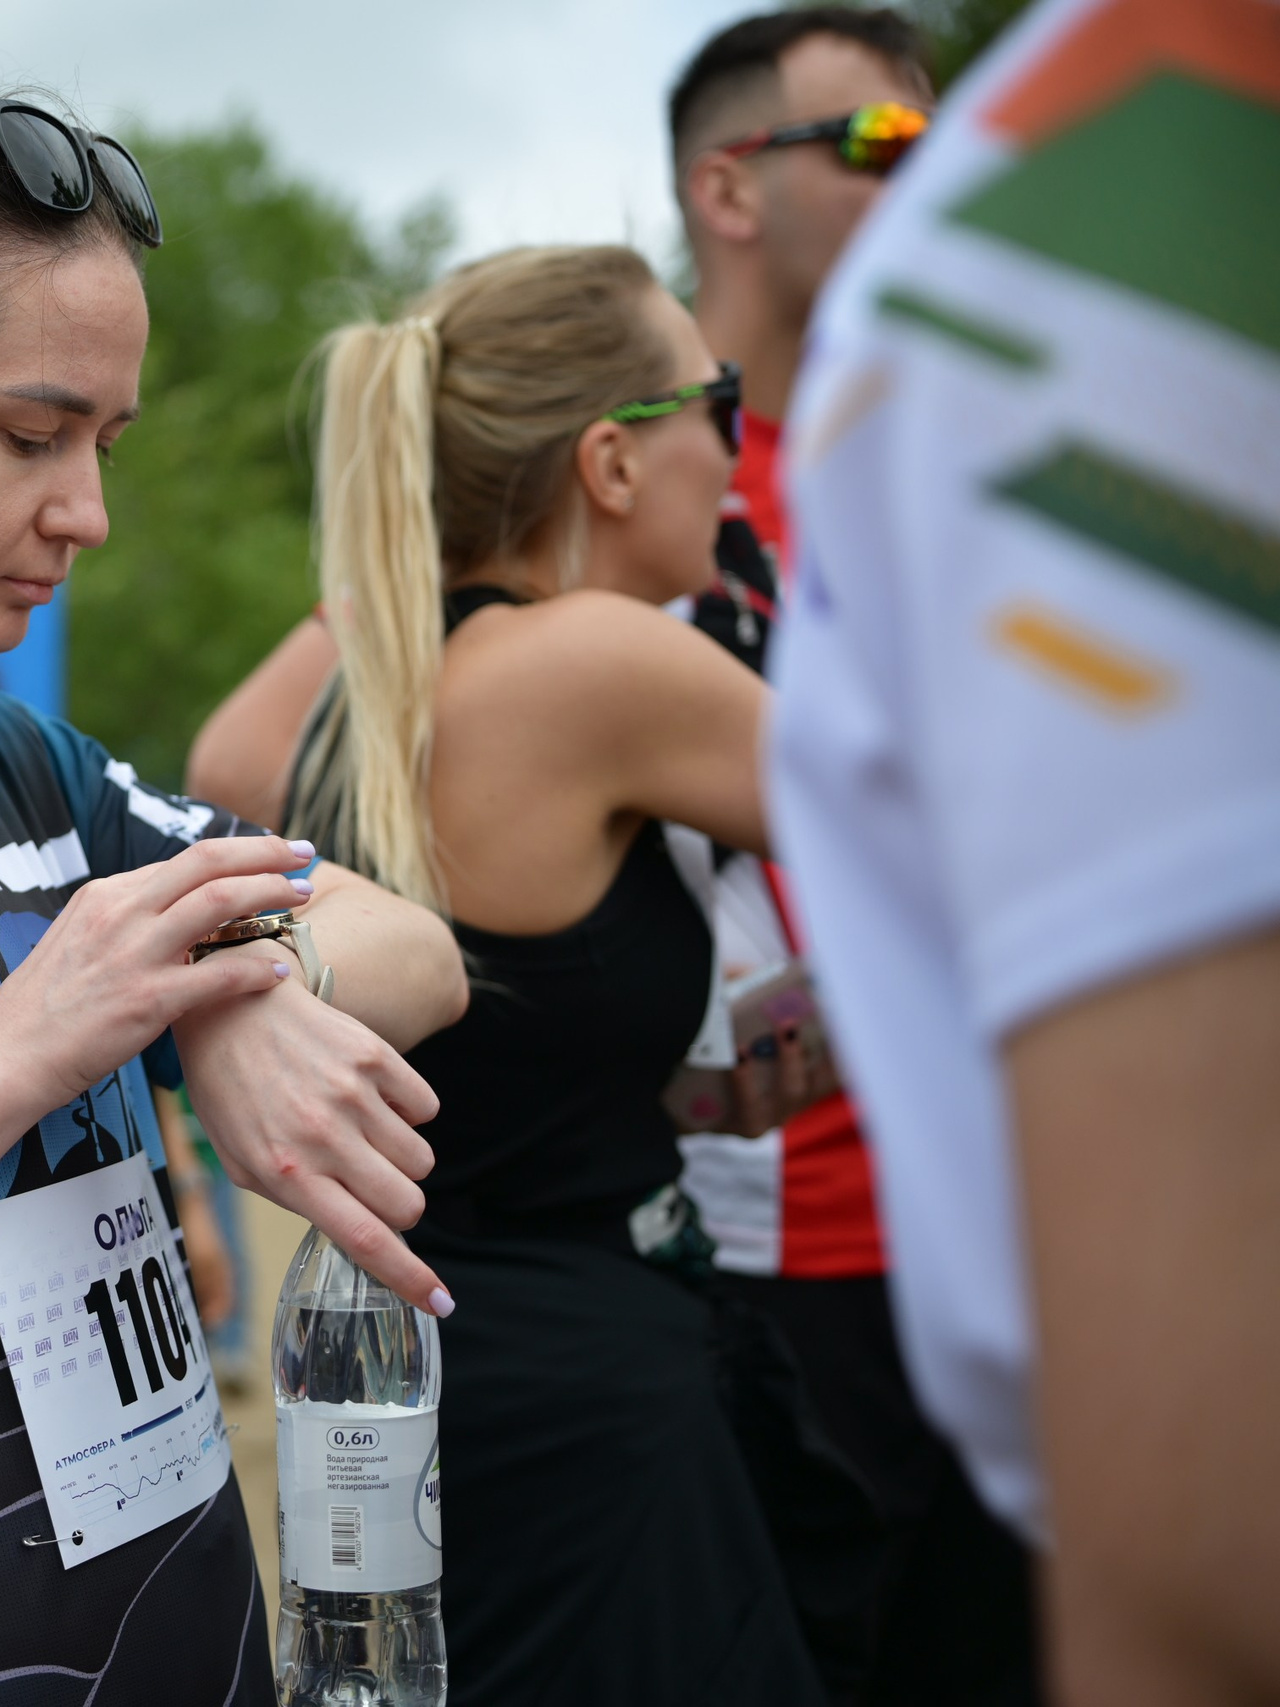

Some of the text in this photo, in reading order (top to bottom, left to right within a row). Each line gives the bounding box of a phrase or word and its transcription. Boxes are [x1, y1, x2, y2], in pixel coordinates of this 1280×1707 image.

[334, 1431, 373, 1447] 0,6л
[55, 1438, 116, 1471] АТМОСФЕРА
[326, 1453, 388, 1464] Вода природная
[327, 1474, 380, 1482] артезианская
[327, 1483, 390, 1492] негазированная
